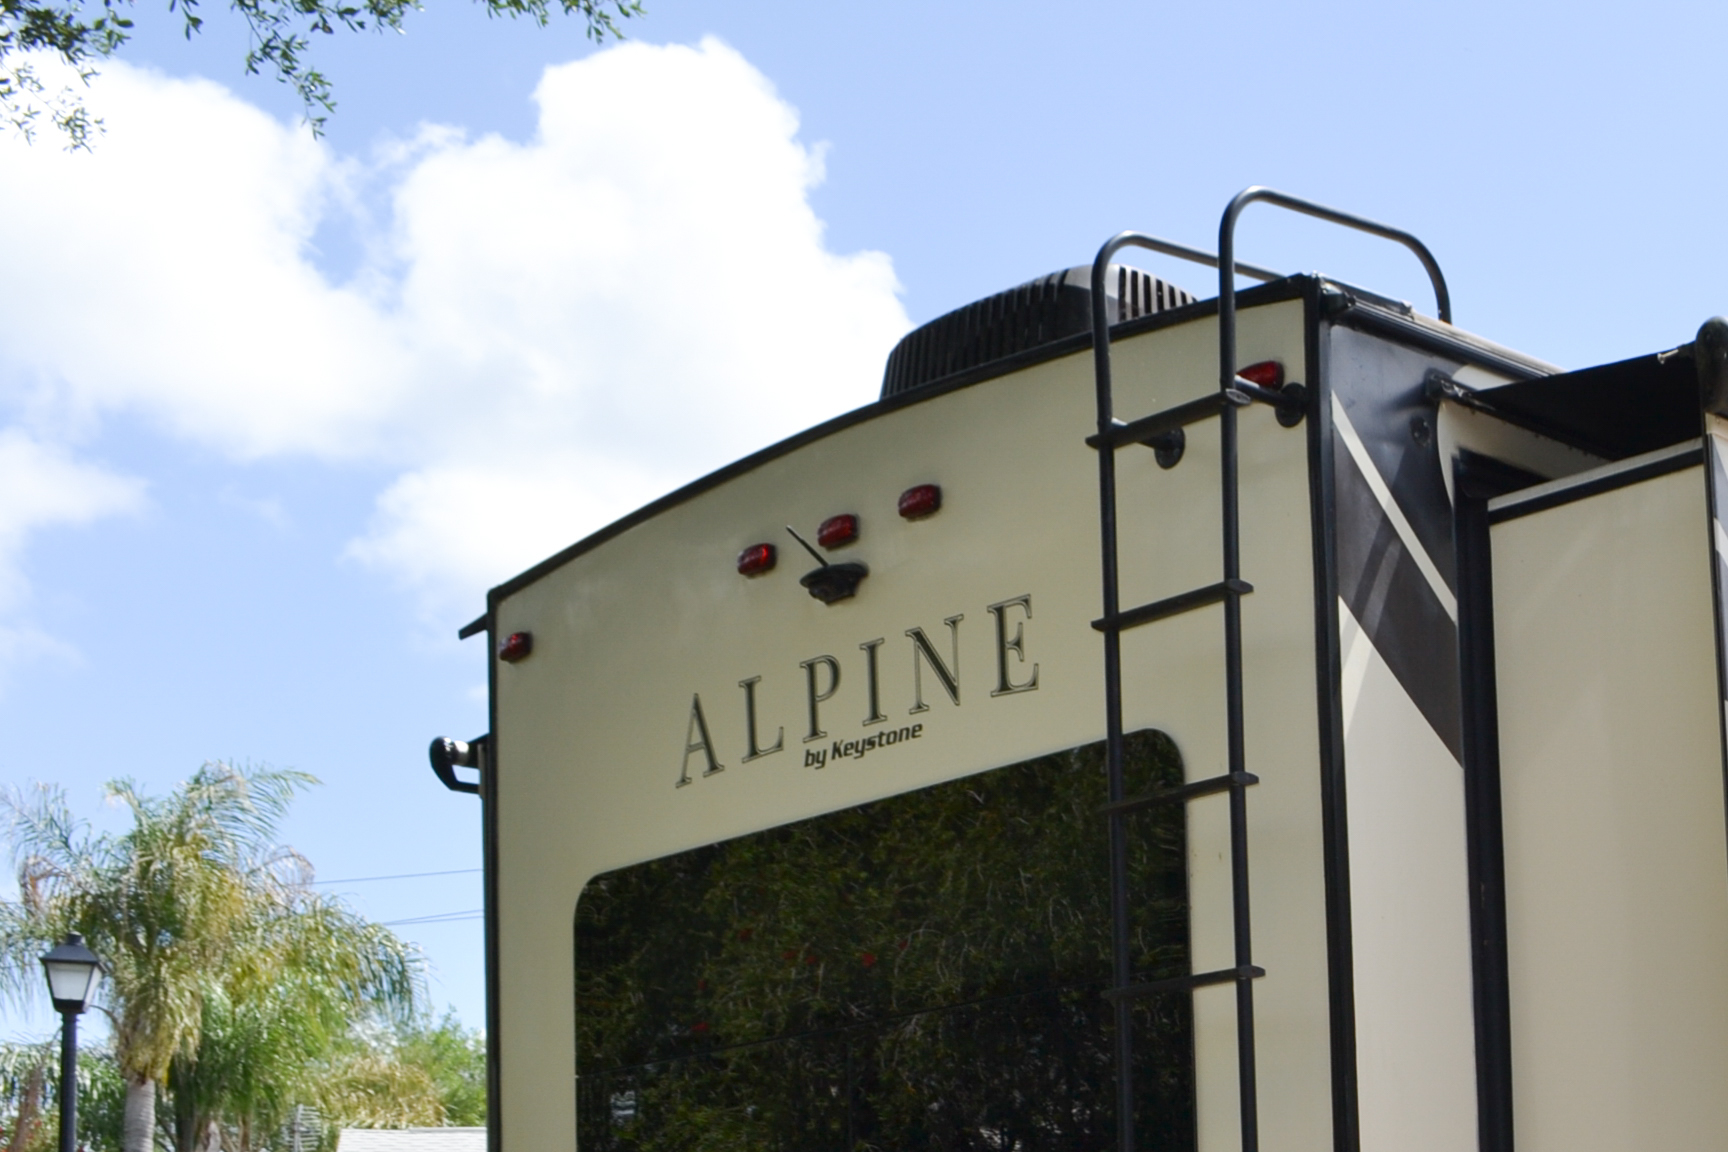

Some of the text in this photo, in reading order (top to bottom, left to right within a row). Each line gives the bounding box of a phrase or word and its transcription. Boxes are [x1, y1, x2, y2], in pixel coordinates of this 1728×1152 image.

[675, 593, 1040, 789] ALPINE
[804, 723, 923, 770] by Keystone
